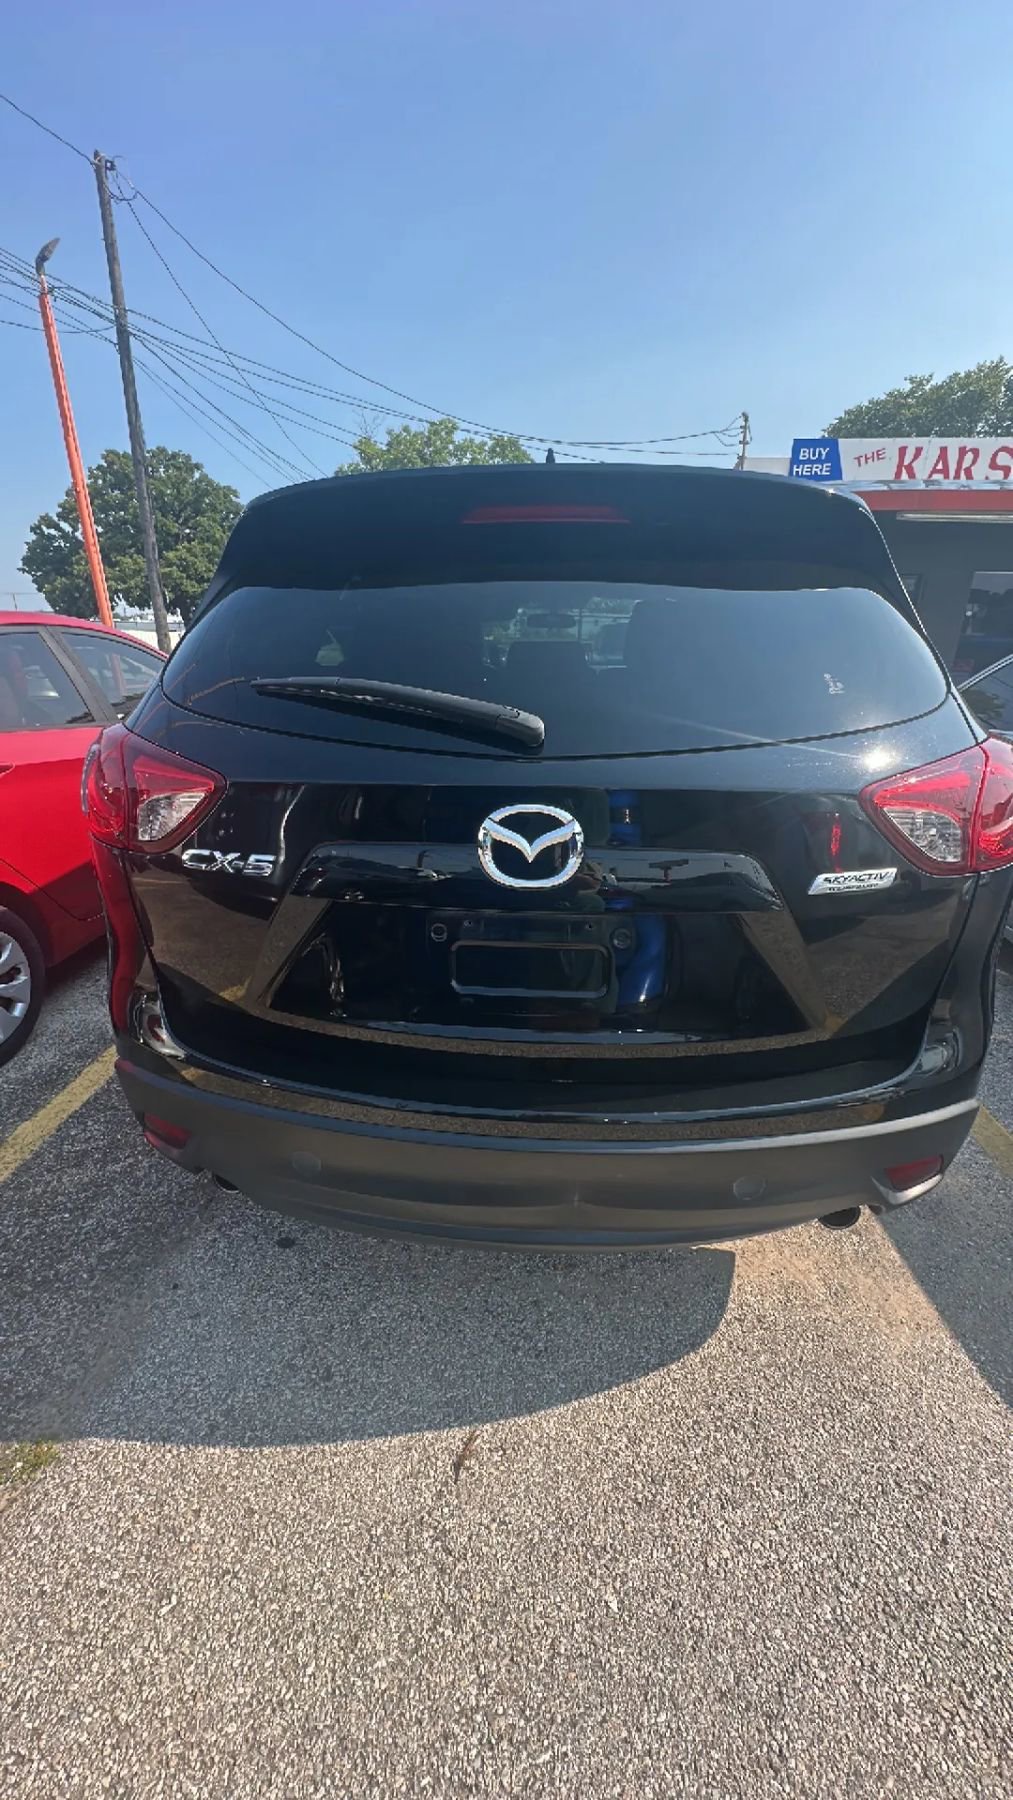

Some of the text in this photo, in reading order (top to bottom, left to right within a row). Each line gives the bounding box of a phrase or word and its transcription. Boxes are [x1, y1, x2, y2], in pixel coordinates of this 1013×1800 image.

[799, 448, 829, 460] BUY
[853, 447, 886, 467] THE
[793, 463, 831, 476] HERE
[181, 849, 276, 876] CX-5
[823, 872, 889, 884] SKYACTIV
